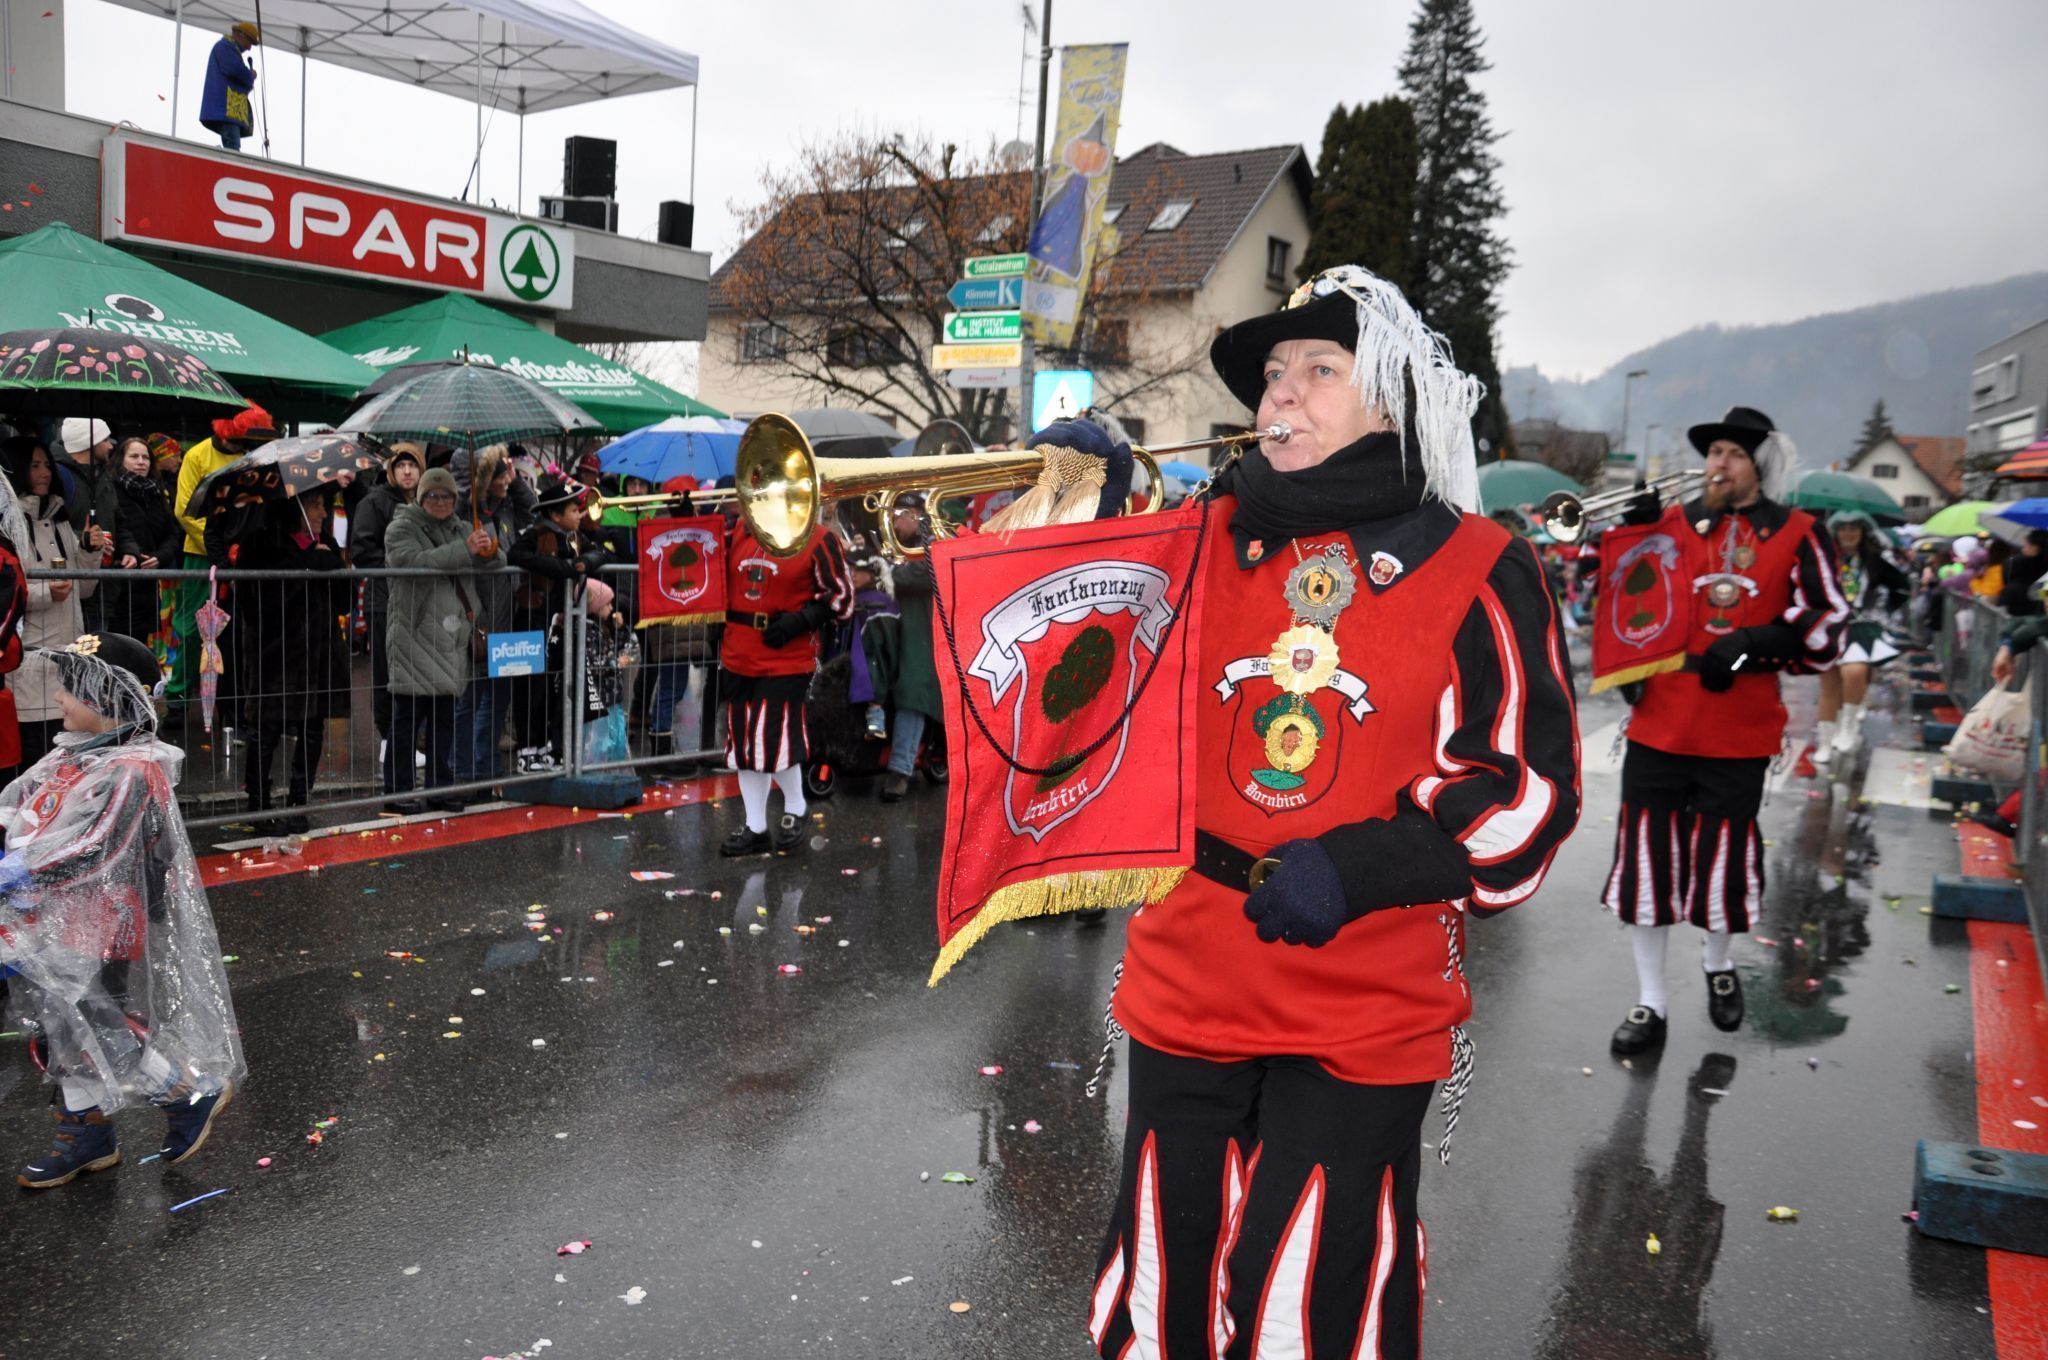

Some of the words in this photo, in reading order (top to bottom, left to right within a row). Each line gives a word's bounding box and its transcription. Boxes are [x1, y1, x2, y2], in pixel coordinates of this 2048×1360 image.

[213, 176, 480, 280] SPAR
[974, 260, 1024, 274] Sozialzentrum
[57, 311, 242, 349] MOHREN
[968, 327, 983, 338] DR.
[984, 326, 1019, 338] HUEMER
[969, 317, 1005, 328] INSTITUT
[1027, 575, 1146, 621] Fanfarenzug
[491, 640, 541, 662] pfeiffer
[1243, 780, 1307, 808] Dornbirn
